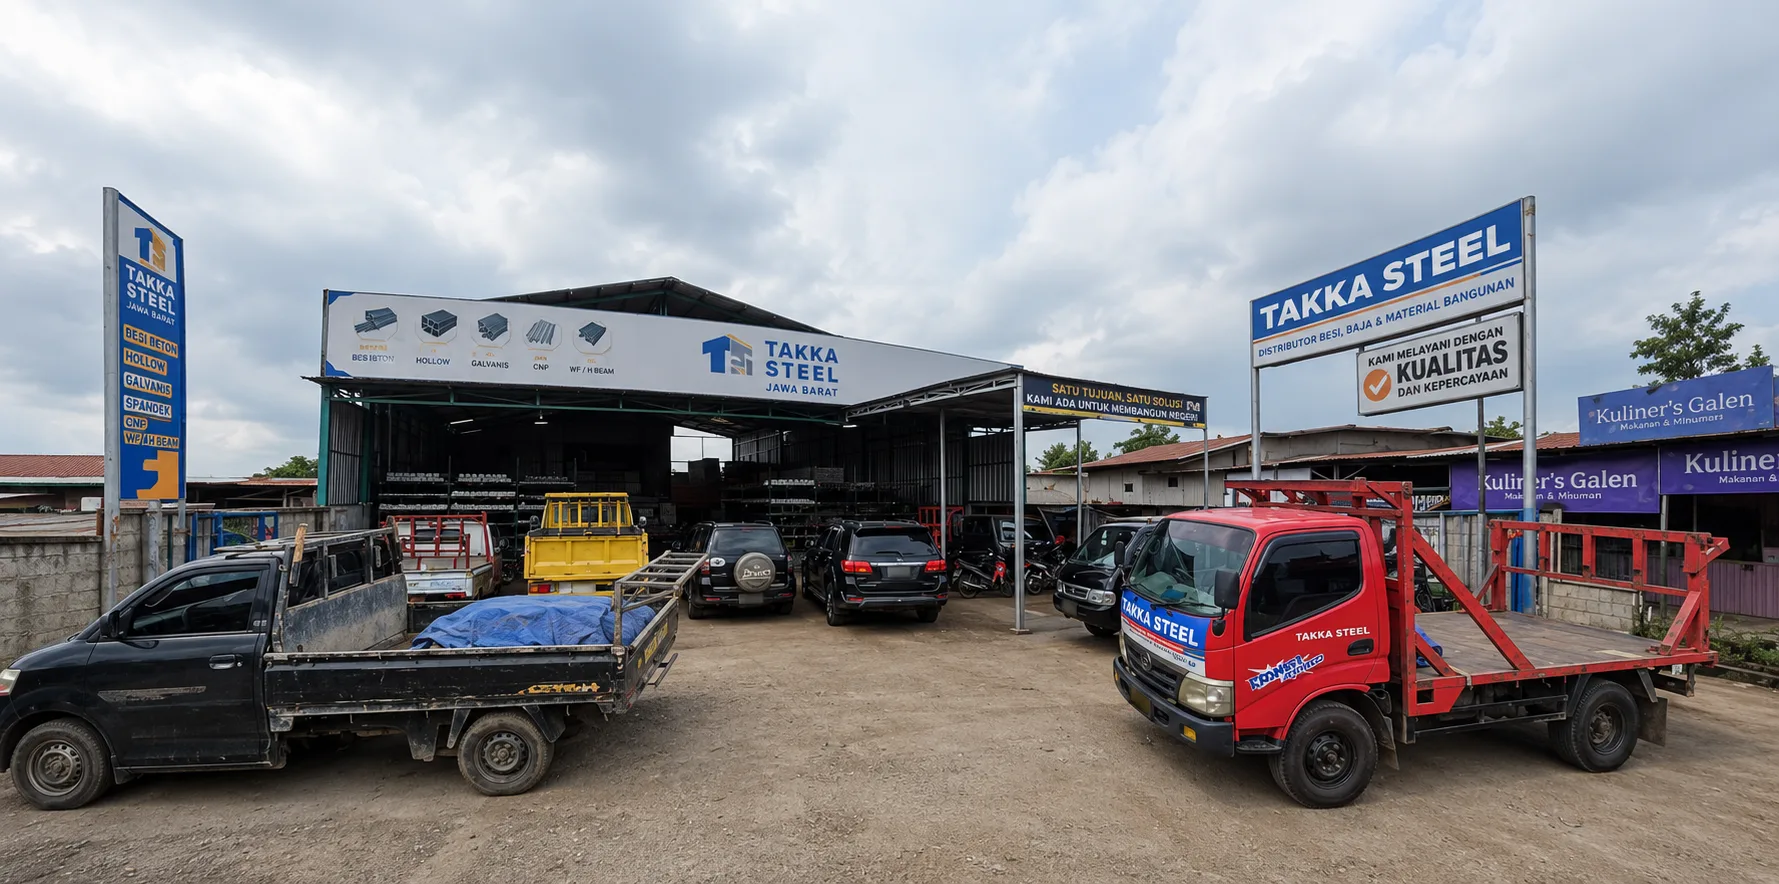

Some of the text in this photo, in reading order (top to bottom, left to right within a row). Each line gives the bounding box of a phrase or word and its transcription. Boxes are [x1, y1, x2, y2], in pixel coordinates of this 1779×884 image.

[125, 263, 175, 301] TAKKA
[1259, 224, 1511, 330] TAKKA STEEL
[126, 283, 176, 316] STEEL
[126, 301, 149, 317] JAWA
[1258, 276, 1515, 358] DISTRIBUTOR BESI, BAJA & MATERIAL BANGUNAN
[125, 327, 147, 344] BESI
[1368, 326, 1503, 367] KAMI MELAYANI DENGAN
[125, 351, 166, 373] HOLLOW
[415, 357, 451, 366] HOLLOW
[764, 340, 839, 364] TAKKA
[1396, 340, 1508, 384] KUALITAS
[471, 359, 509, 369] GALVANIS
[532, 363, 549, 371] CNP
[594, 367, 615, 375] BEAM
[765, 360, 839, 383] STEEL
[125, 374, 171, 396] GALVANIS
[766, 383, 838, 397] JAWA BARAT
[1052, 382, 1080, 397] SATU
[1126, 394, 1151, 405] SATU
[1397, 367, 1508, 398] DAN KEPERCAYAAN
[125, 397, 171, 416] SPANDEK
[1027, 393, 1053, 406] KAMI
[1055, 396, 1076, 409] ADA
[1078, 399, 1110, 412] UNTUK
[1111, 404, 1167, 419] MEMBANGUN
[1596, 392, 1755, 424] Kuliner's Galen
[1663, 419, 1670, 427] &
[1684, 449, 1779, 474] Kuline
[1570, 469, 1638, 489] Galen
[1547, 492, 1554, 500] &
[1122, 597, 1151, 628] TAKKA
[1153, 616, 1199, 647] STEEL
[1295, 626, 1371, 642] TAKKA STEEL
